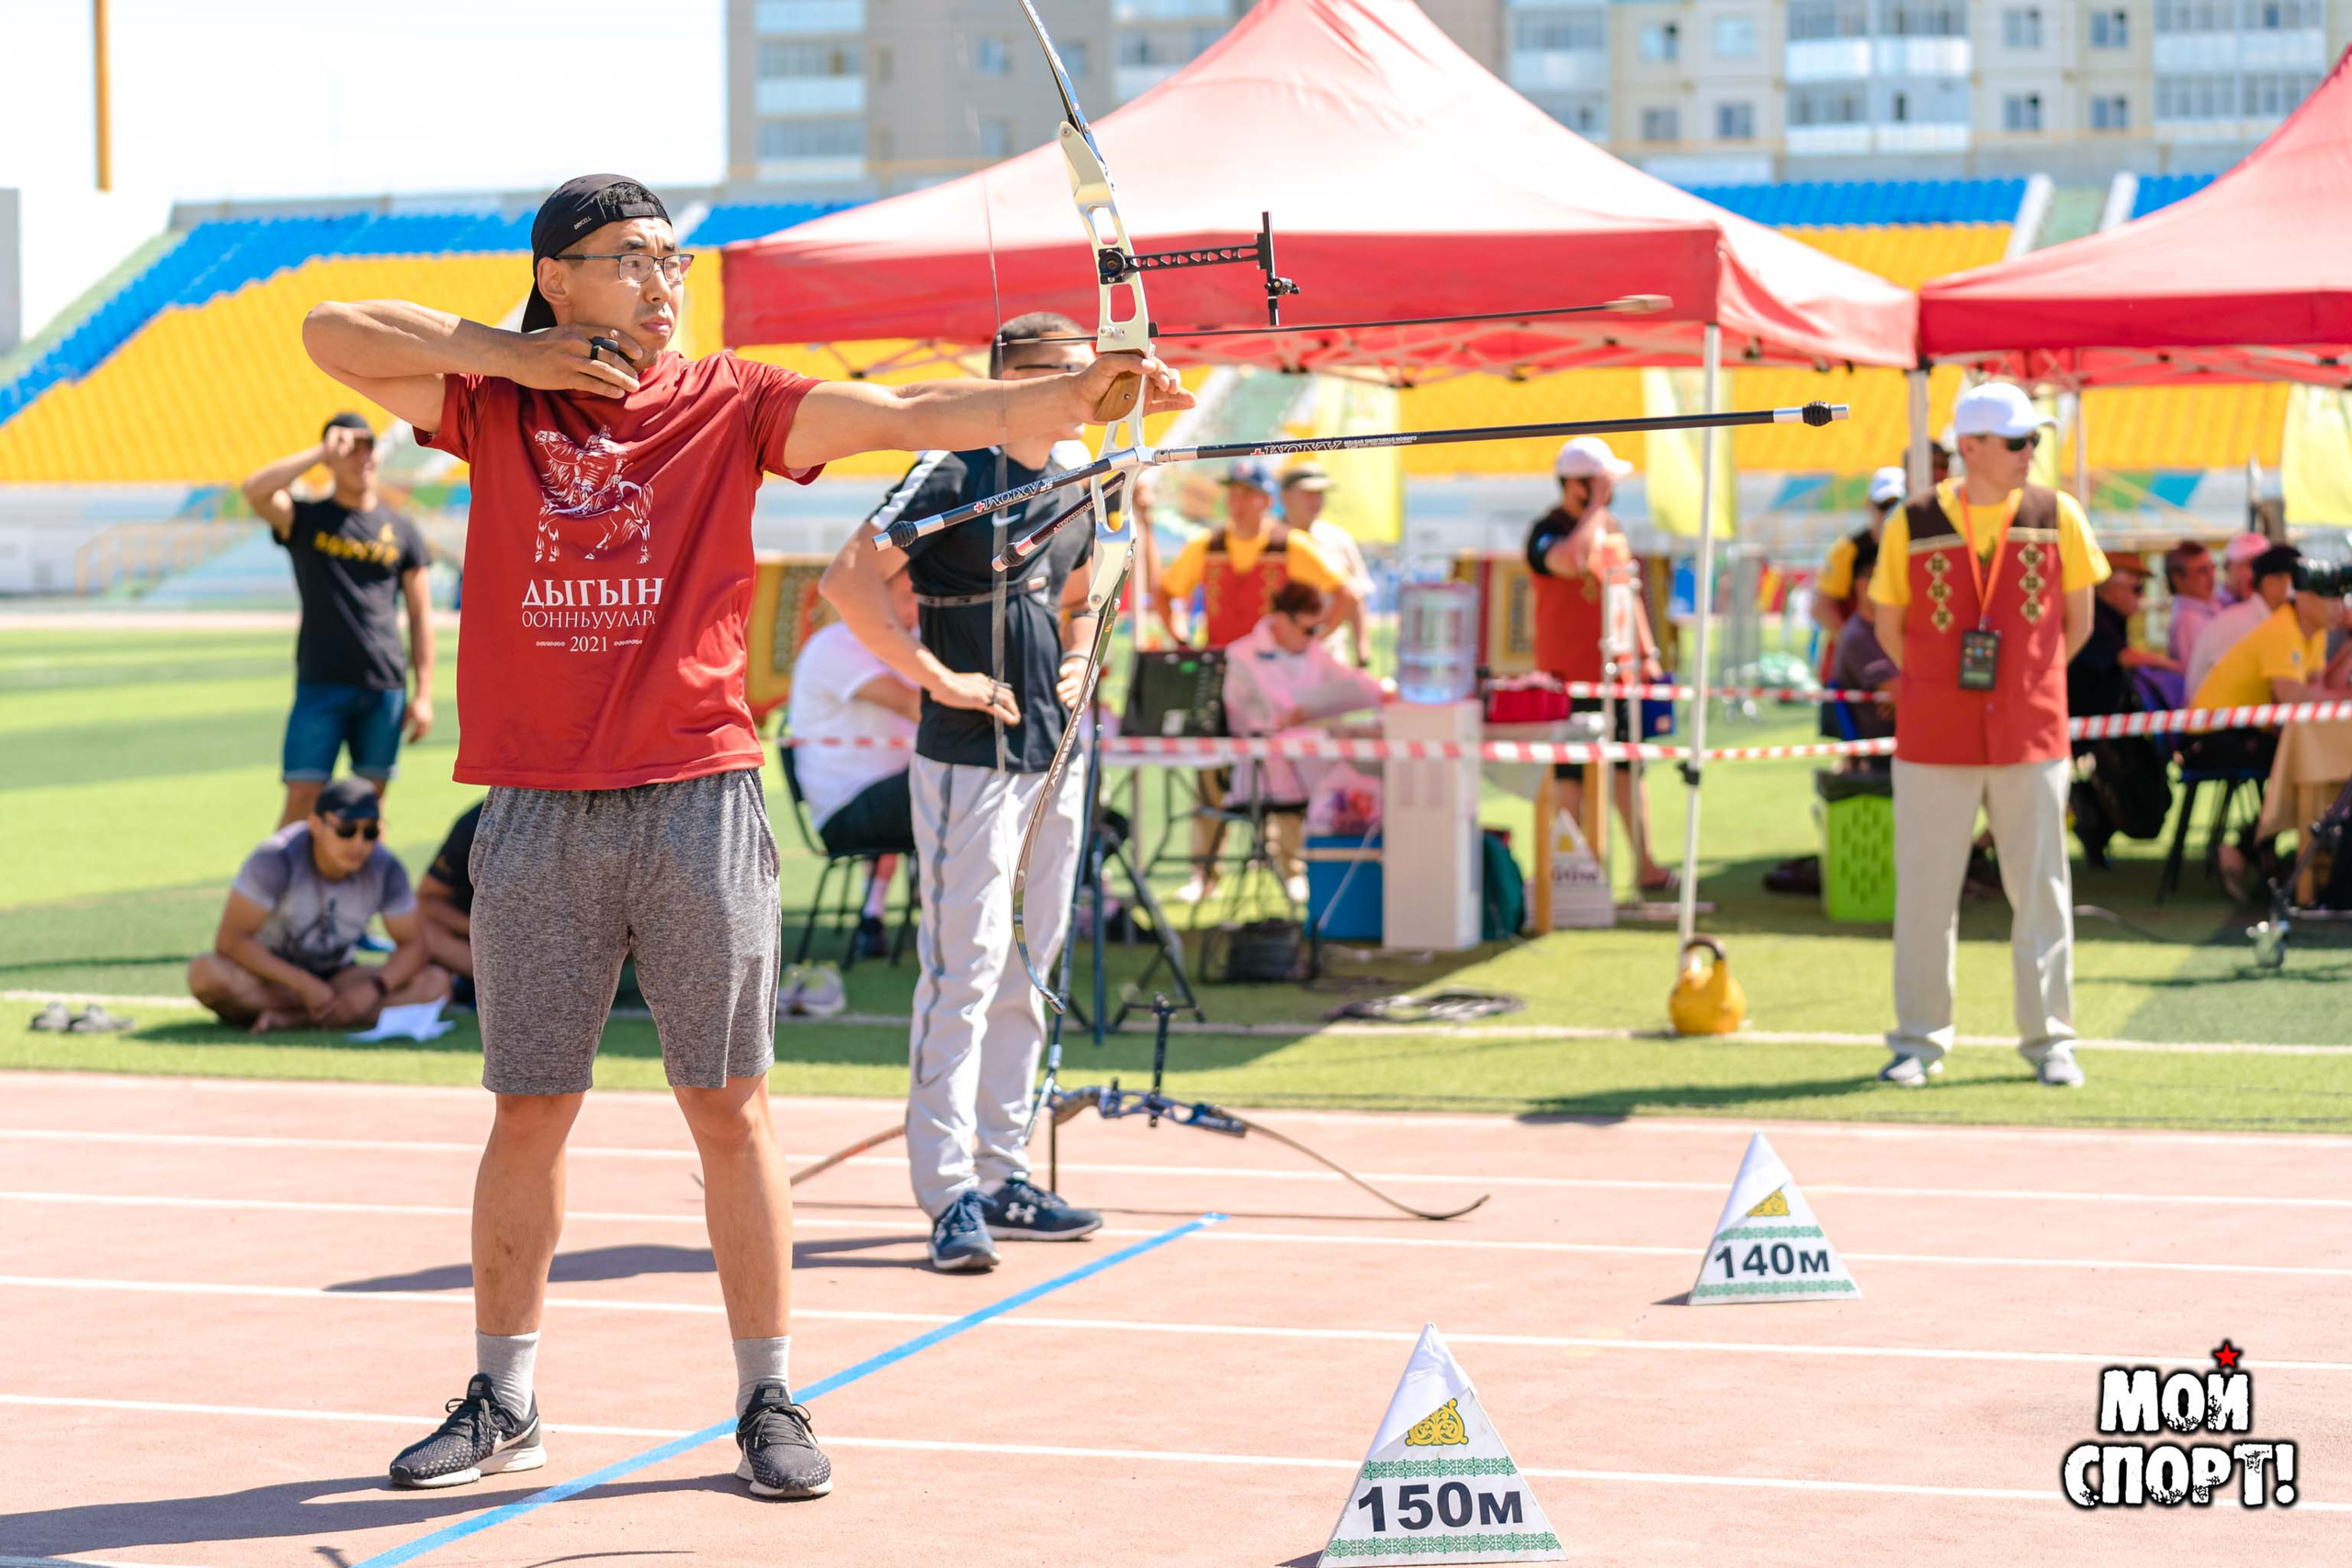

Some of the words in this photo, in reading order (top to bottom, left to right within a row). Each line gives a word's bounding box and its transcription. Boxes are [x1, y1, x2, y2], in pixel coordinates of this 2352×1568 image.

[522, 578, 664, 608] ДЫГЫН
[570, 636, 607, 652] 2021
[1050, 701, 1086, 787] ARCHERY
